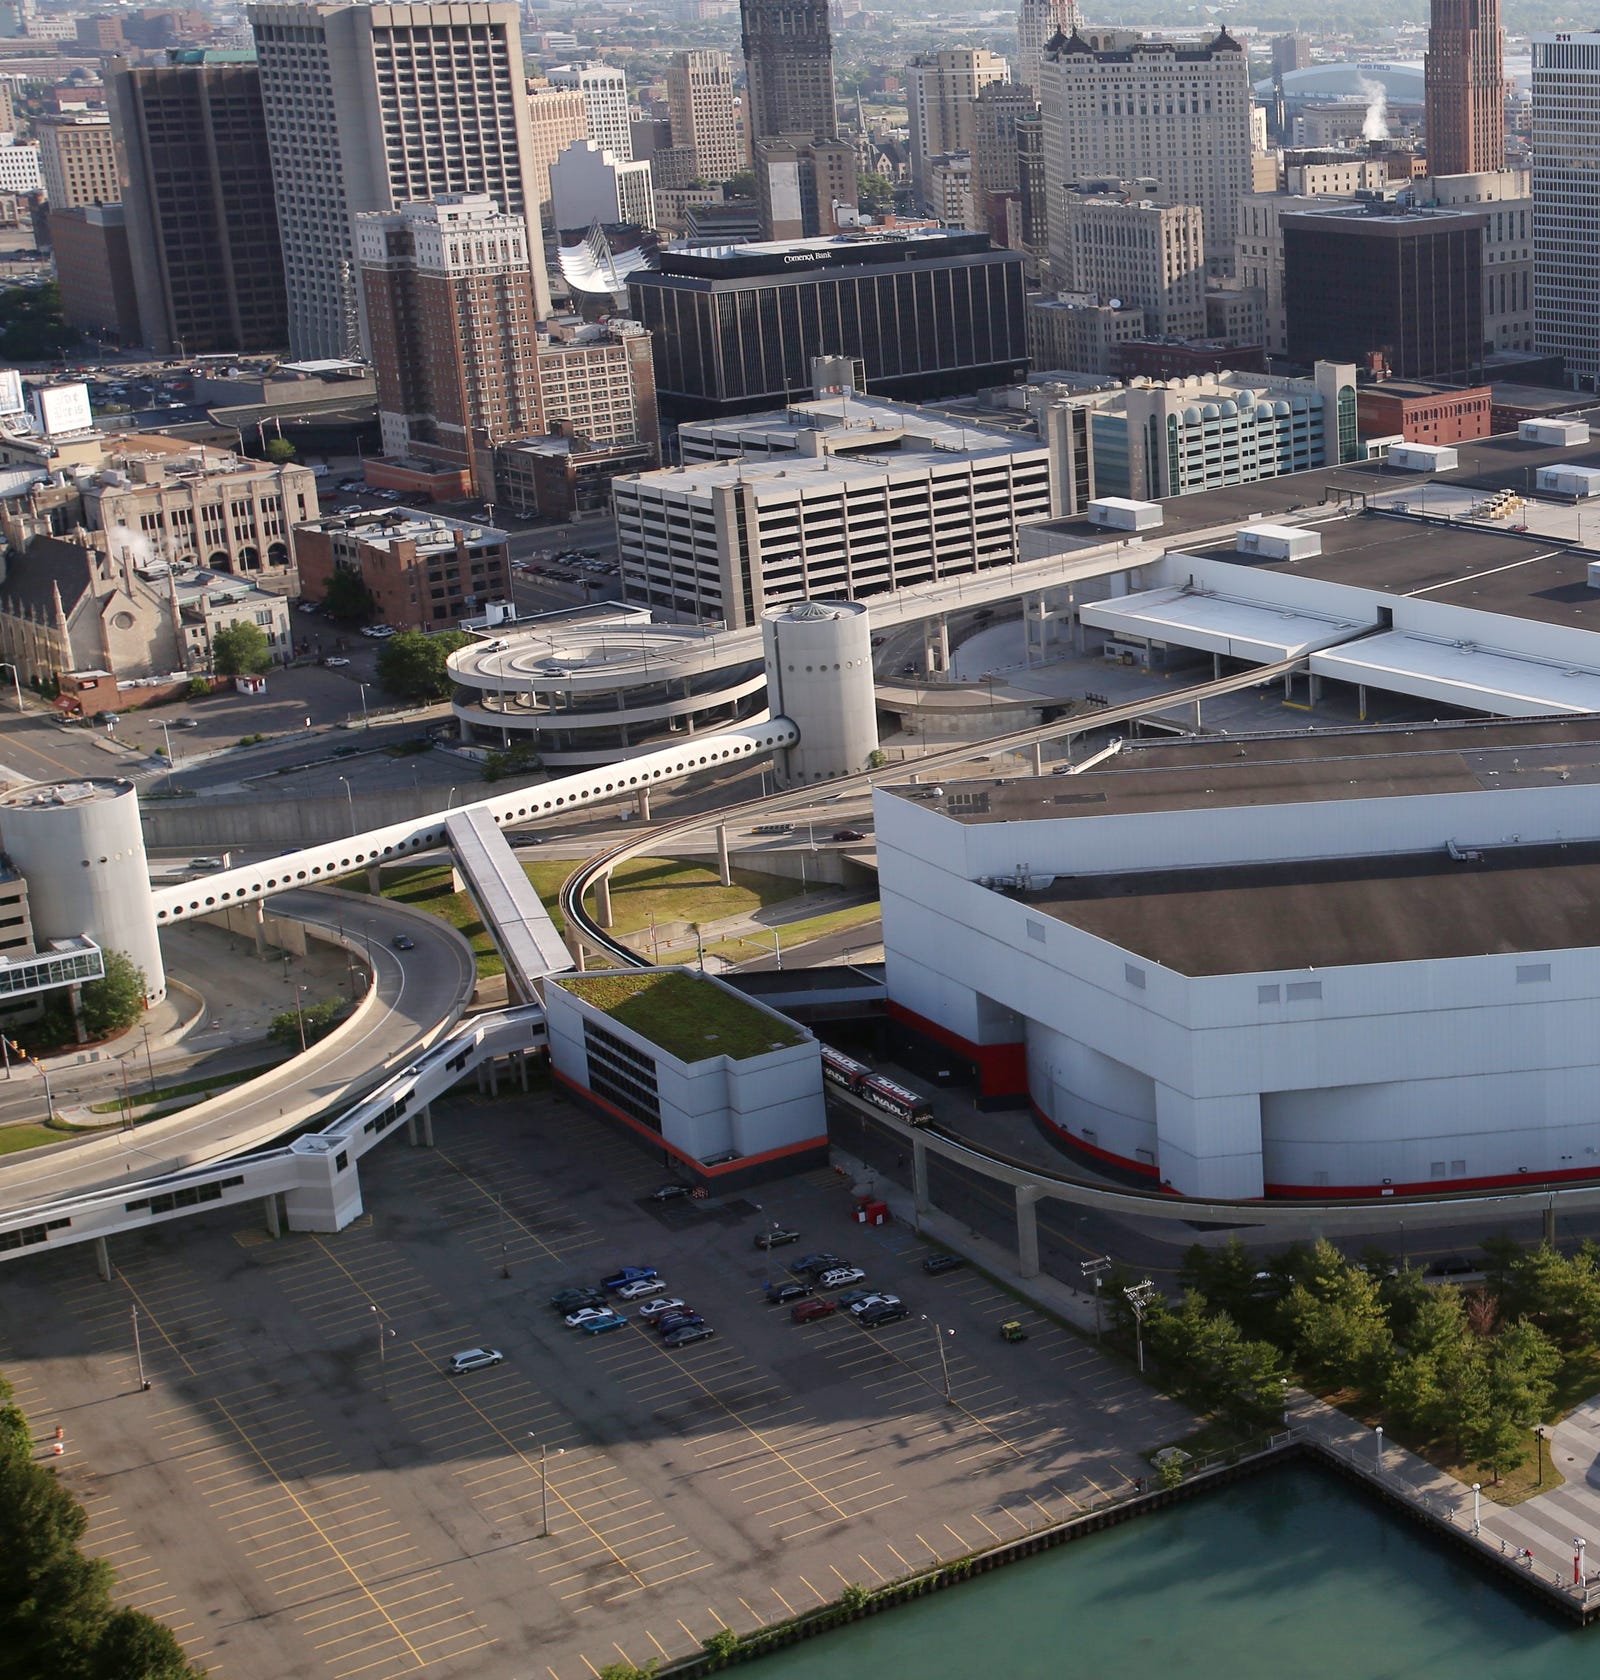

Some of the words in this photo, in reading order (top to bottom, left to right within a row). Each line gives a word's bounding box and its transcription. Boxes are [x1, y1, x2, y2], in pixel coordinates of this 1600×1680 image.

[1555, 33, 1571, 41] 211
[815, 251, 832, 260] Bank
[872, 1094, 906, 1117] WADL
